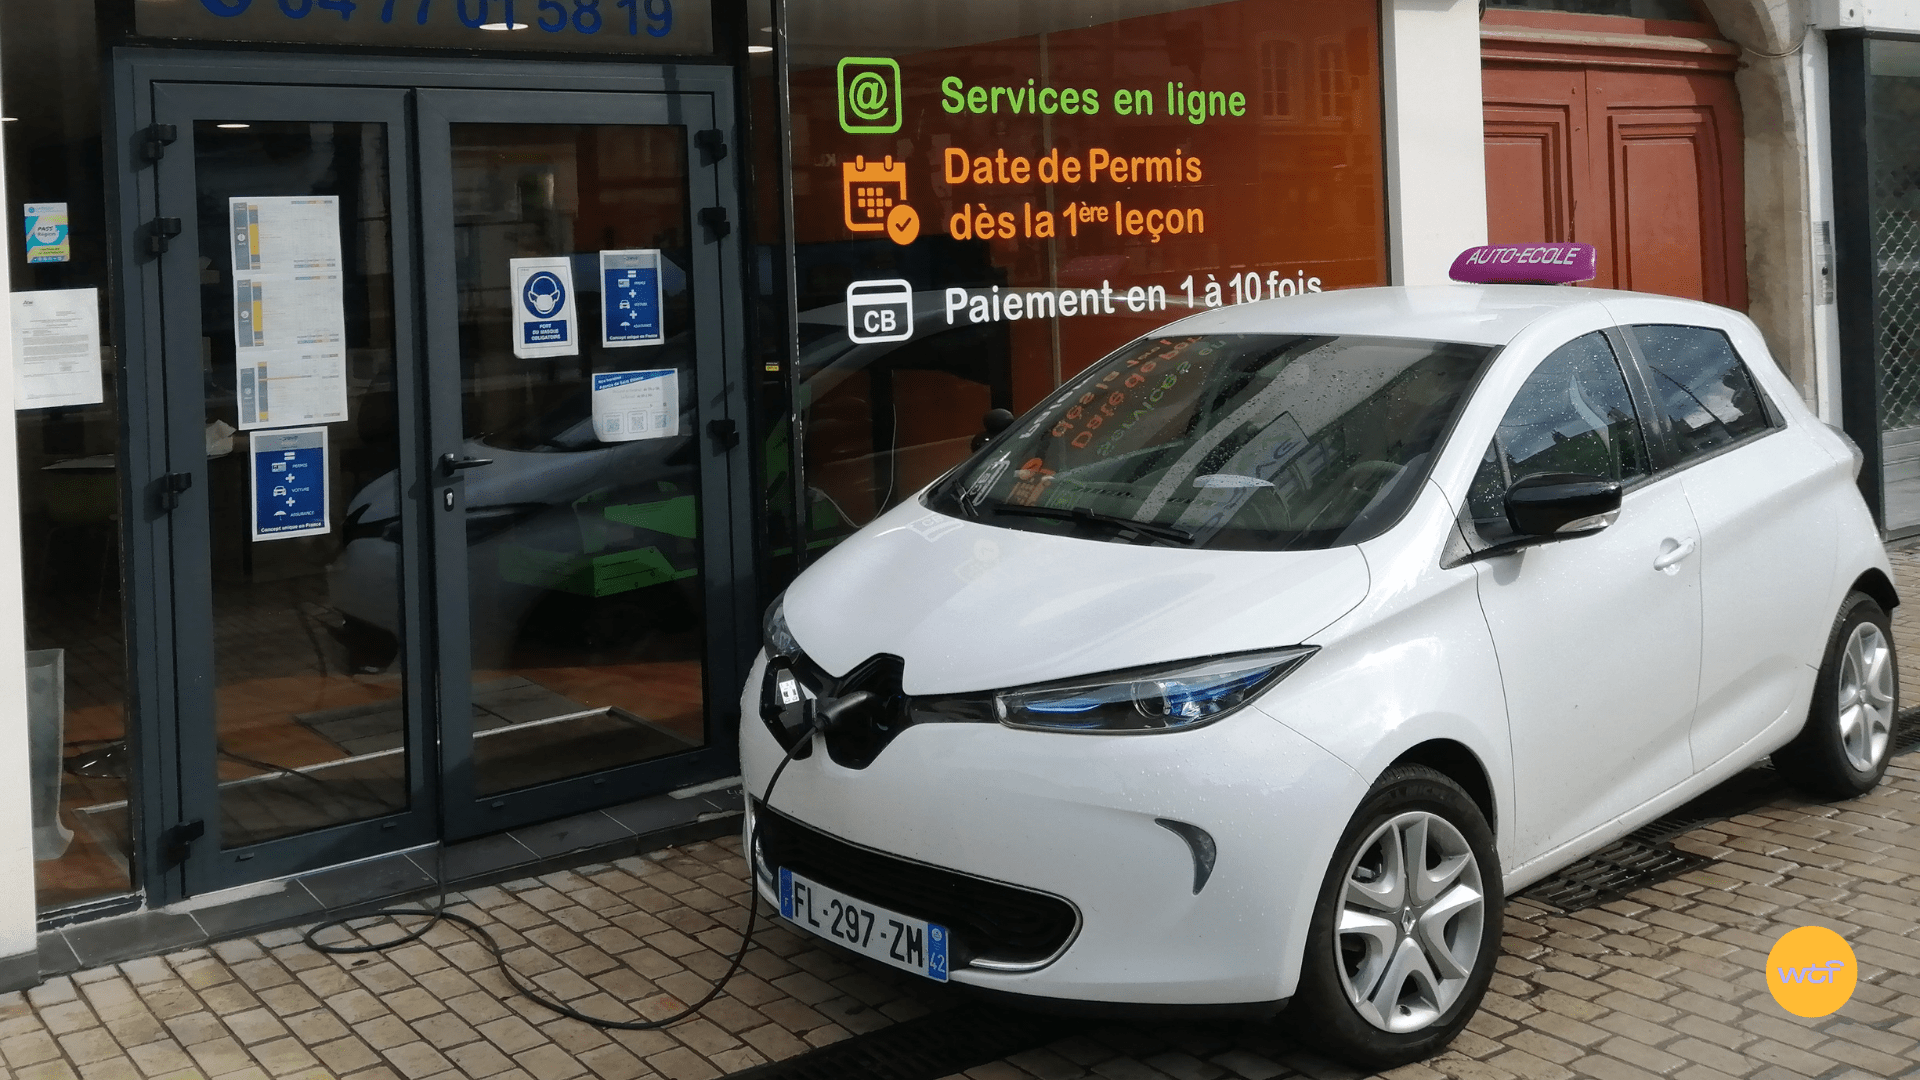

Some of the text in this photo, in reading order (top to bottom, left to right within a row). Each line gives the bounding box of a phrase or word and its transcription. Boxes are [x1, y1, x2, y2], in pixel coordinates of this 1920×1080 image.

[537, 0, 602, 34] 58
[617, 0, 672, 37] 19
[941, 76, 1246, 125] Services en ligne
[944, 147, 1202, 184] Date de Permis
[950, 200, 1204, 243] dès la 1ère leçon
[1466, 246, 1581, 266] AUTO-ECOLE
[945, 269, 1322, 325] Paiement en 1 à 10 fois
[863, 309, 897, 333] CB
[794, 881, 923, 968] FL-297-ZM
[930, 952, 946, 973] 42
